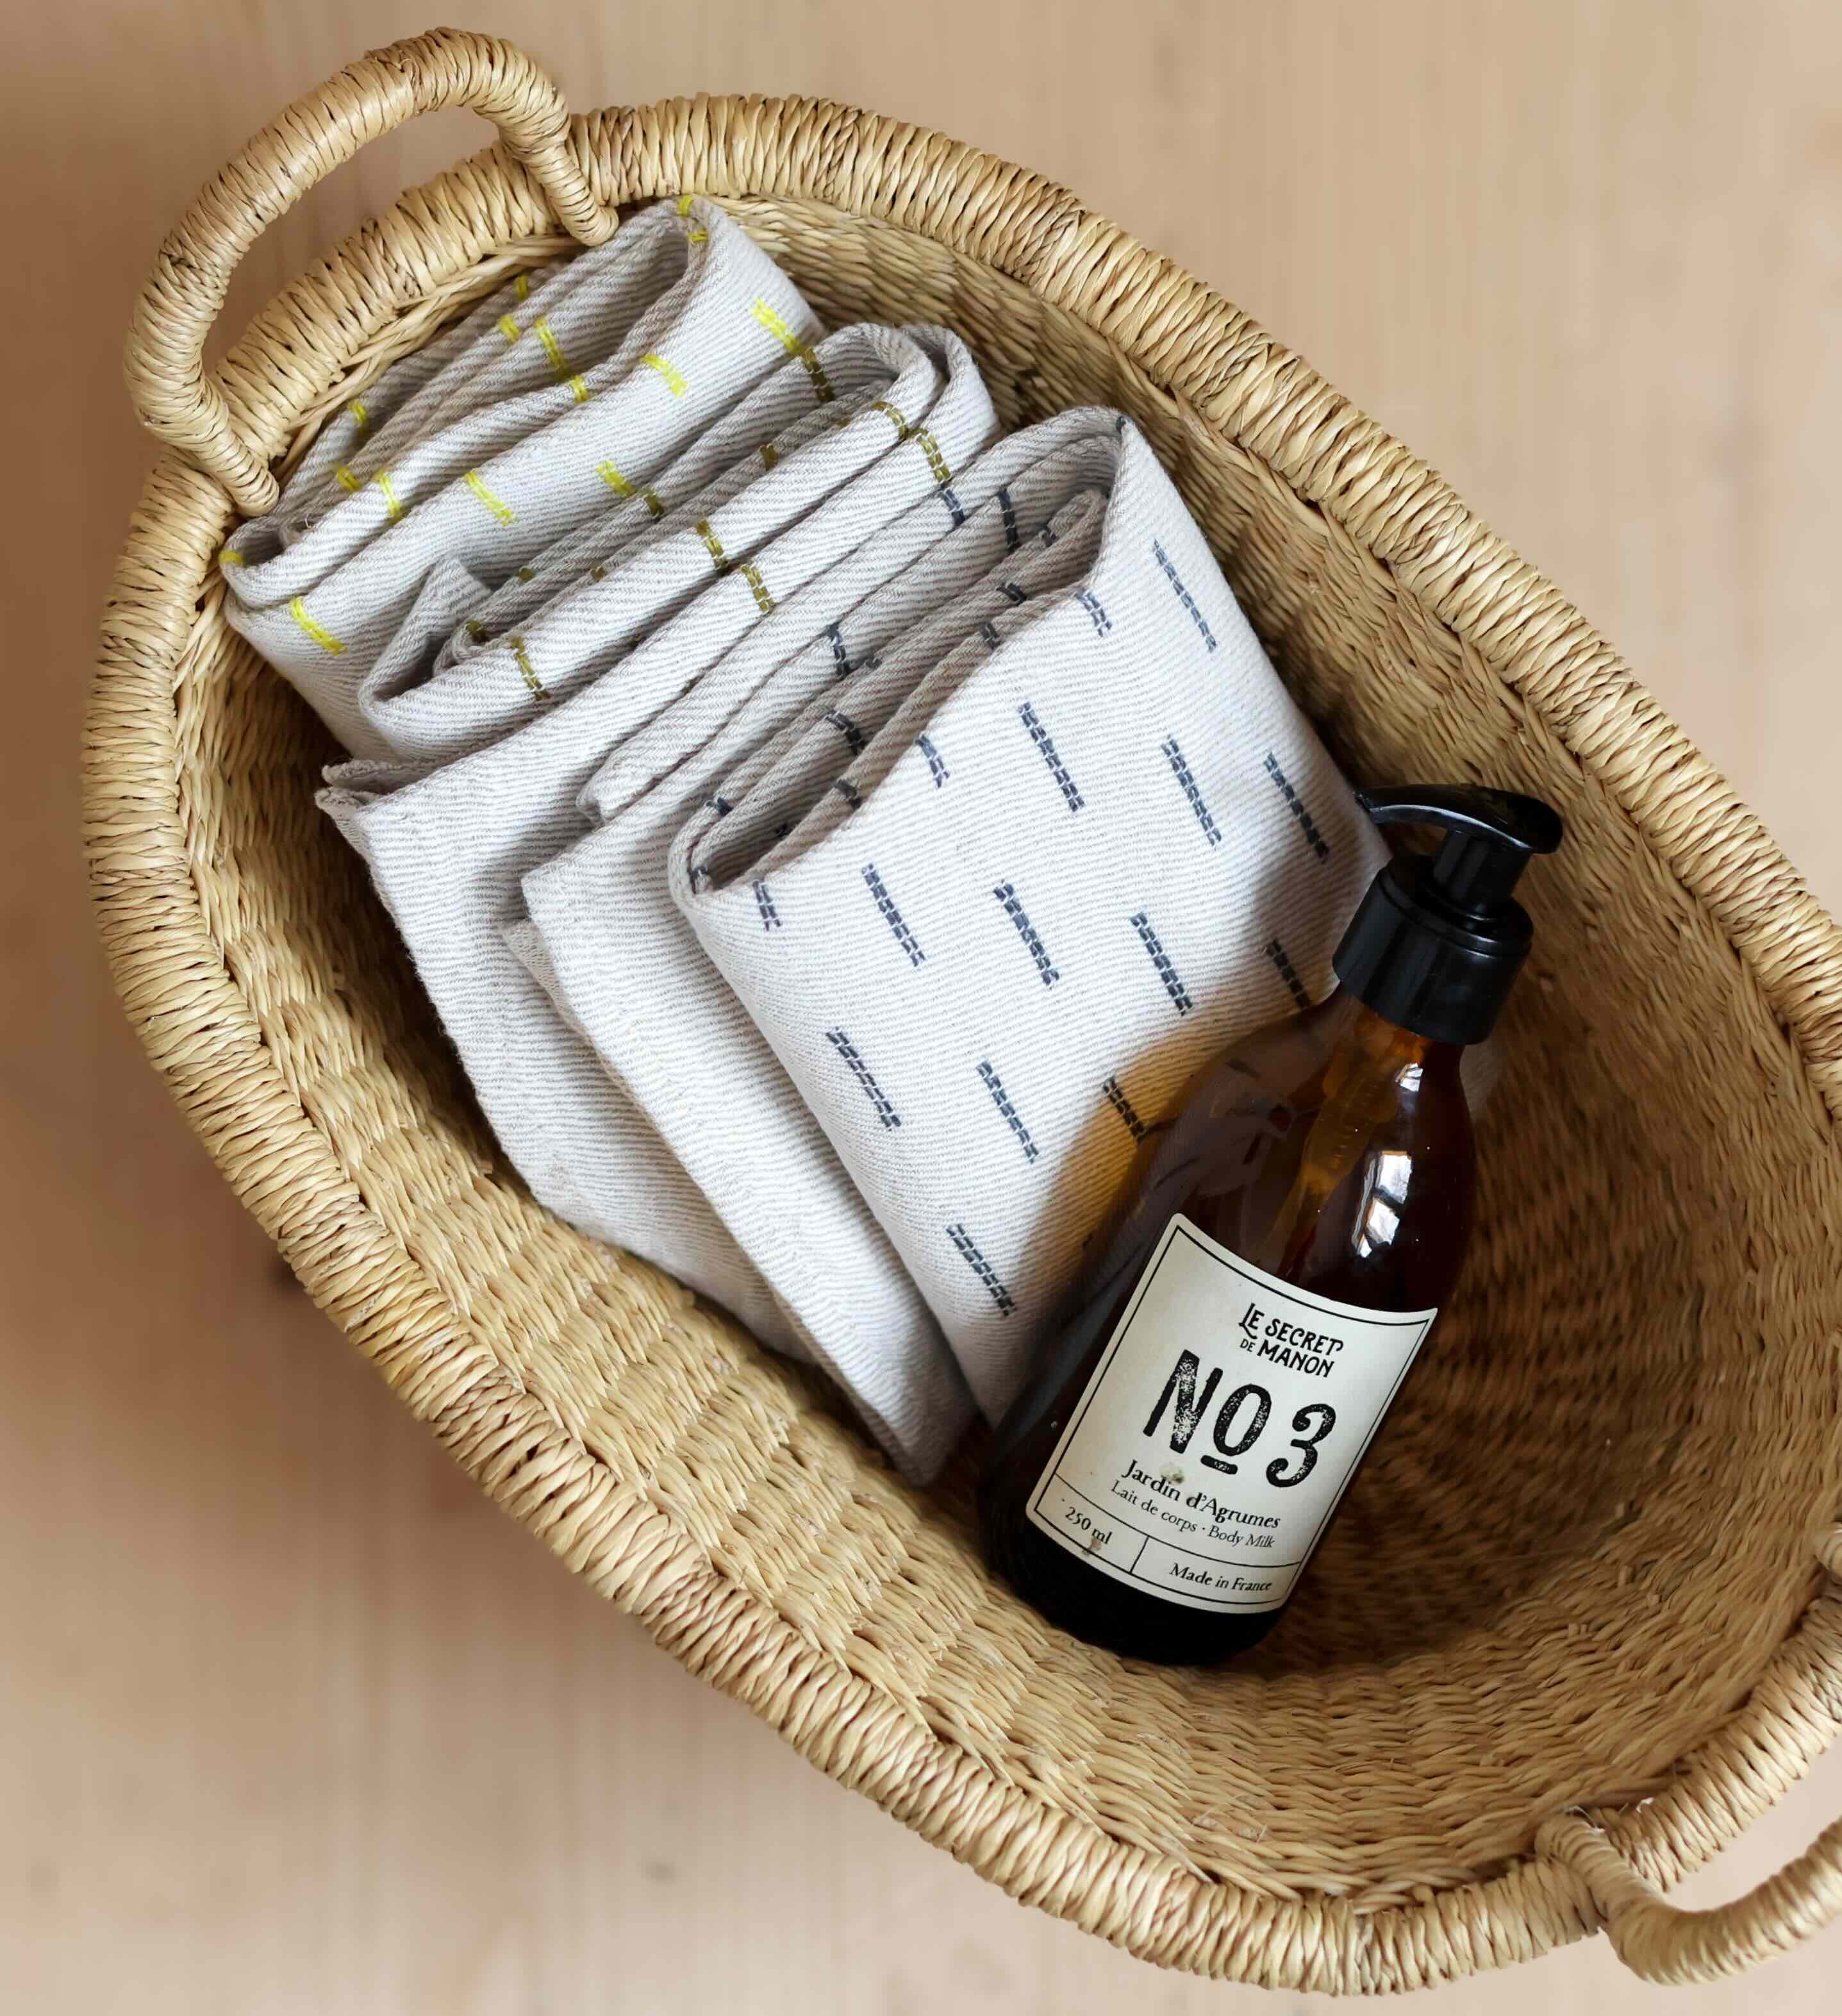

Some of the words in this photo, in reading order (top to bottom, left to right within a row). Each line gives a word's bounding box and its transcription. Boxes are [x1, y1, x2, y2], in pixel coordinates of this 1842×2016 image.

[1238, 1303, 1265, 1339] LE
[1265, 1318, 1344, 1356] SECRET
[1240, 1338, 1256, 1353] DE
[1257, 1339, 1335, 1378] MANON
[1266, 1404, 1336, 1488] 3
[1111, 1479, 1138, 1506] Lait
[1141, 1499, 1159, 1515] de
[1161, 1510, 1198, 1533] corps
[1207, 1525, 1243, 1545] Body
[1245, 1533, 1275, 1548] Milk
[1122, 1460, 1181, 1502] Jardin
[1186, 1492, 1281, 1528] d'Agrumes
[1065, 1506, 1091, 1531] 250
[1091, 1528, 1113, 1545] ml
[1169, 1562, 1213, 1585] Made
[1215, 1575, 1229, 1590] in
[1231, 1576, 1272, 1592] France
